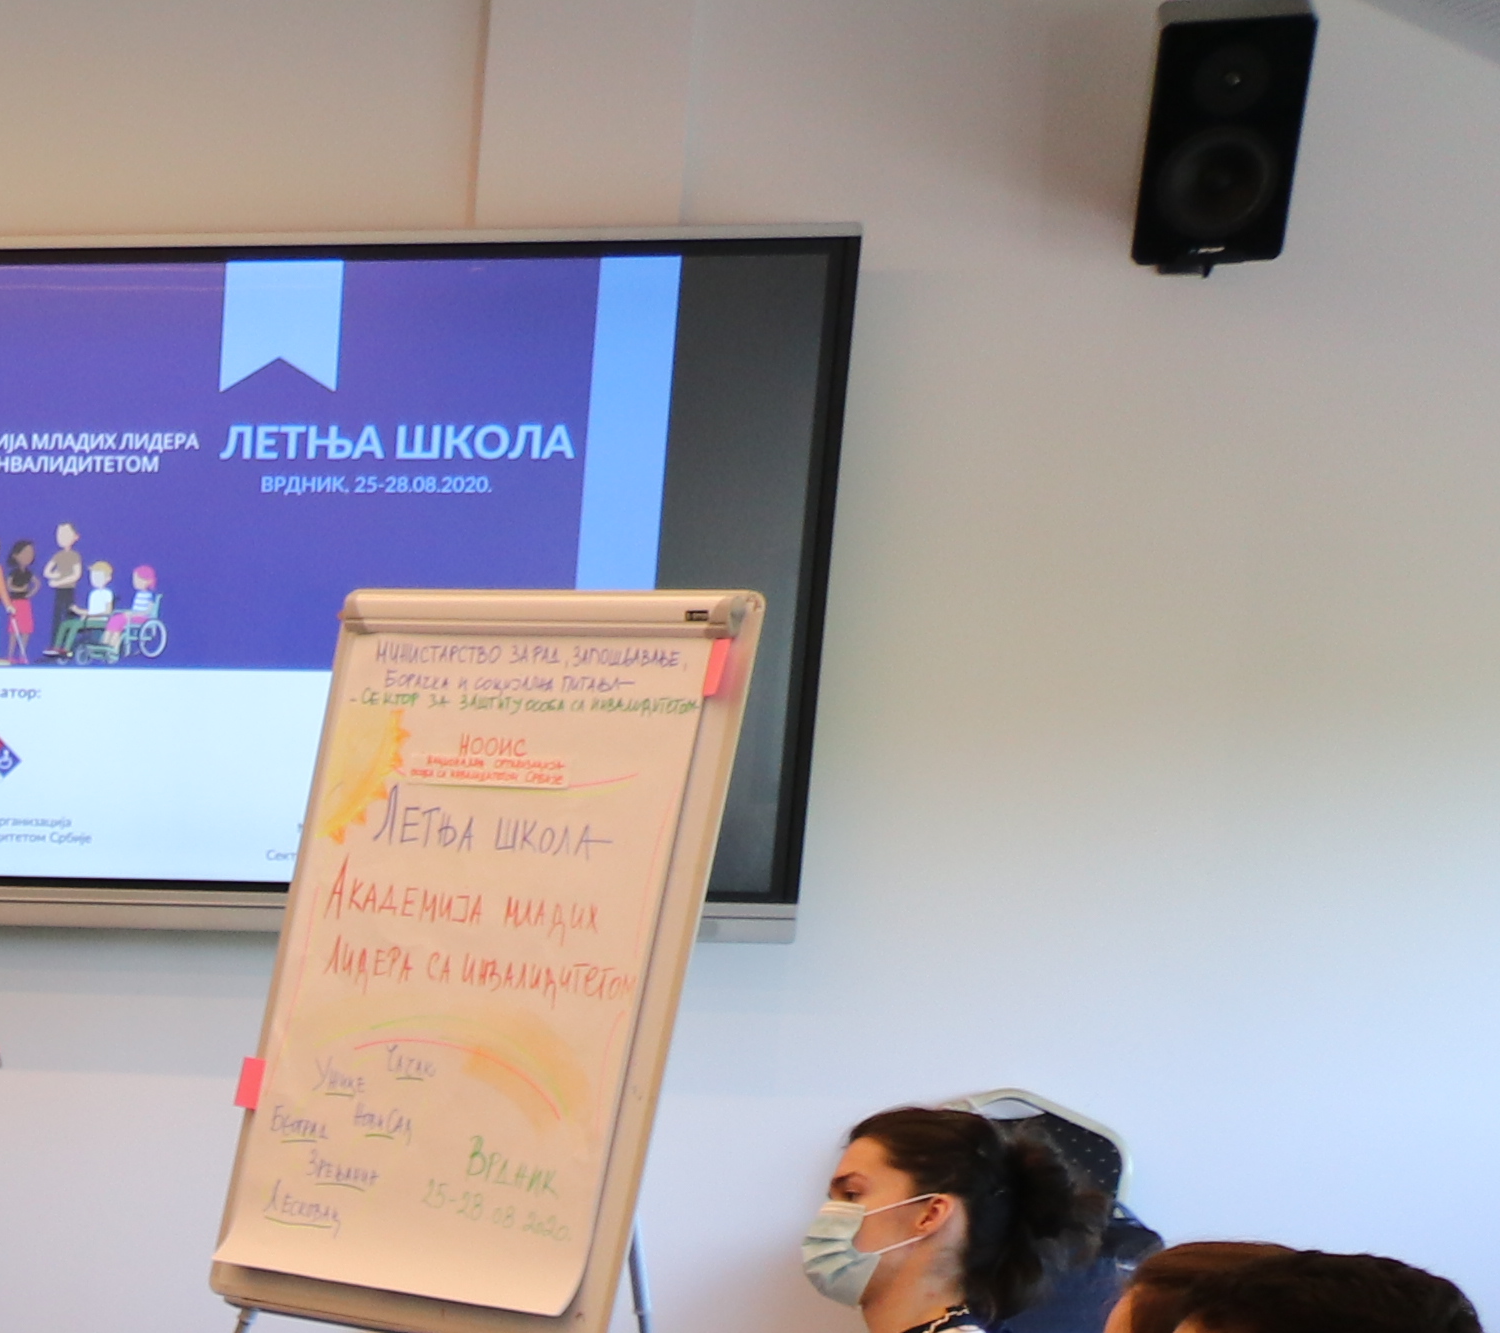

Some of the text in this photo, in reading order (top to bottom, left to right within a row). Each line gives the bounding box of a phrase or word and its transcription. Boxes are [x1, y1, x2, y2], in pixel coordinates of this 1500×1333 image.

[32, 433, 117, 454] МЛАДИХ
[119, 432, 200, 453] ЛИДЕРА
[219, 424, 575, 461] ЛЕТЊА ШКОЛА
[354, 476, 492, 494] 25-28.08.2020.
[460, 732, 527, 757] НООИС
[49, 831, 92, 844] Србије
[374, 786, 613, 861] ЛЕТЊА ШКОЛА
[324, 854, 483, 926] АКАДЕМИЈА
[426, 950, 452, 984] СА
